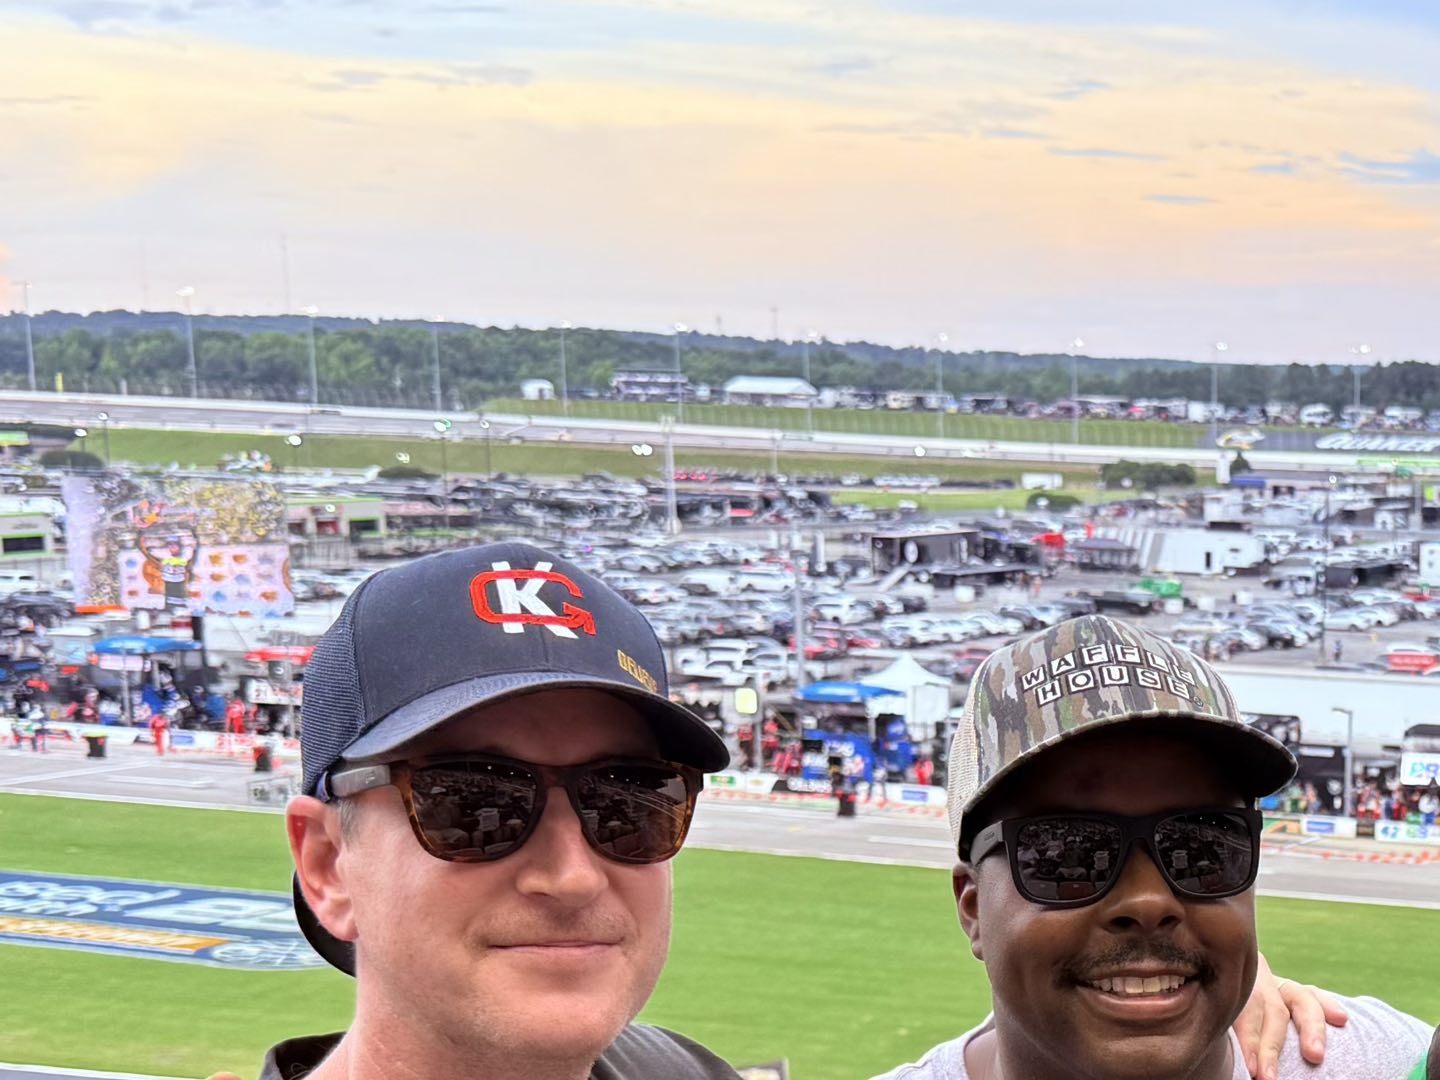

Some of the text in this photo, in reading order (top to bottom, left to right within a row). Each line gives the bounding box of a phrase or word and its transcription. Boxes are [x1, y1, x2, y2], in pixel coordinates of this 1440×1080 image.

[1315, 432, 1437, 453] QUAKER
[1021, 644, 1197, 692] WAFFLE
[1035, 666, 1191, 707] HOUSE
